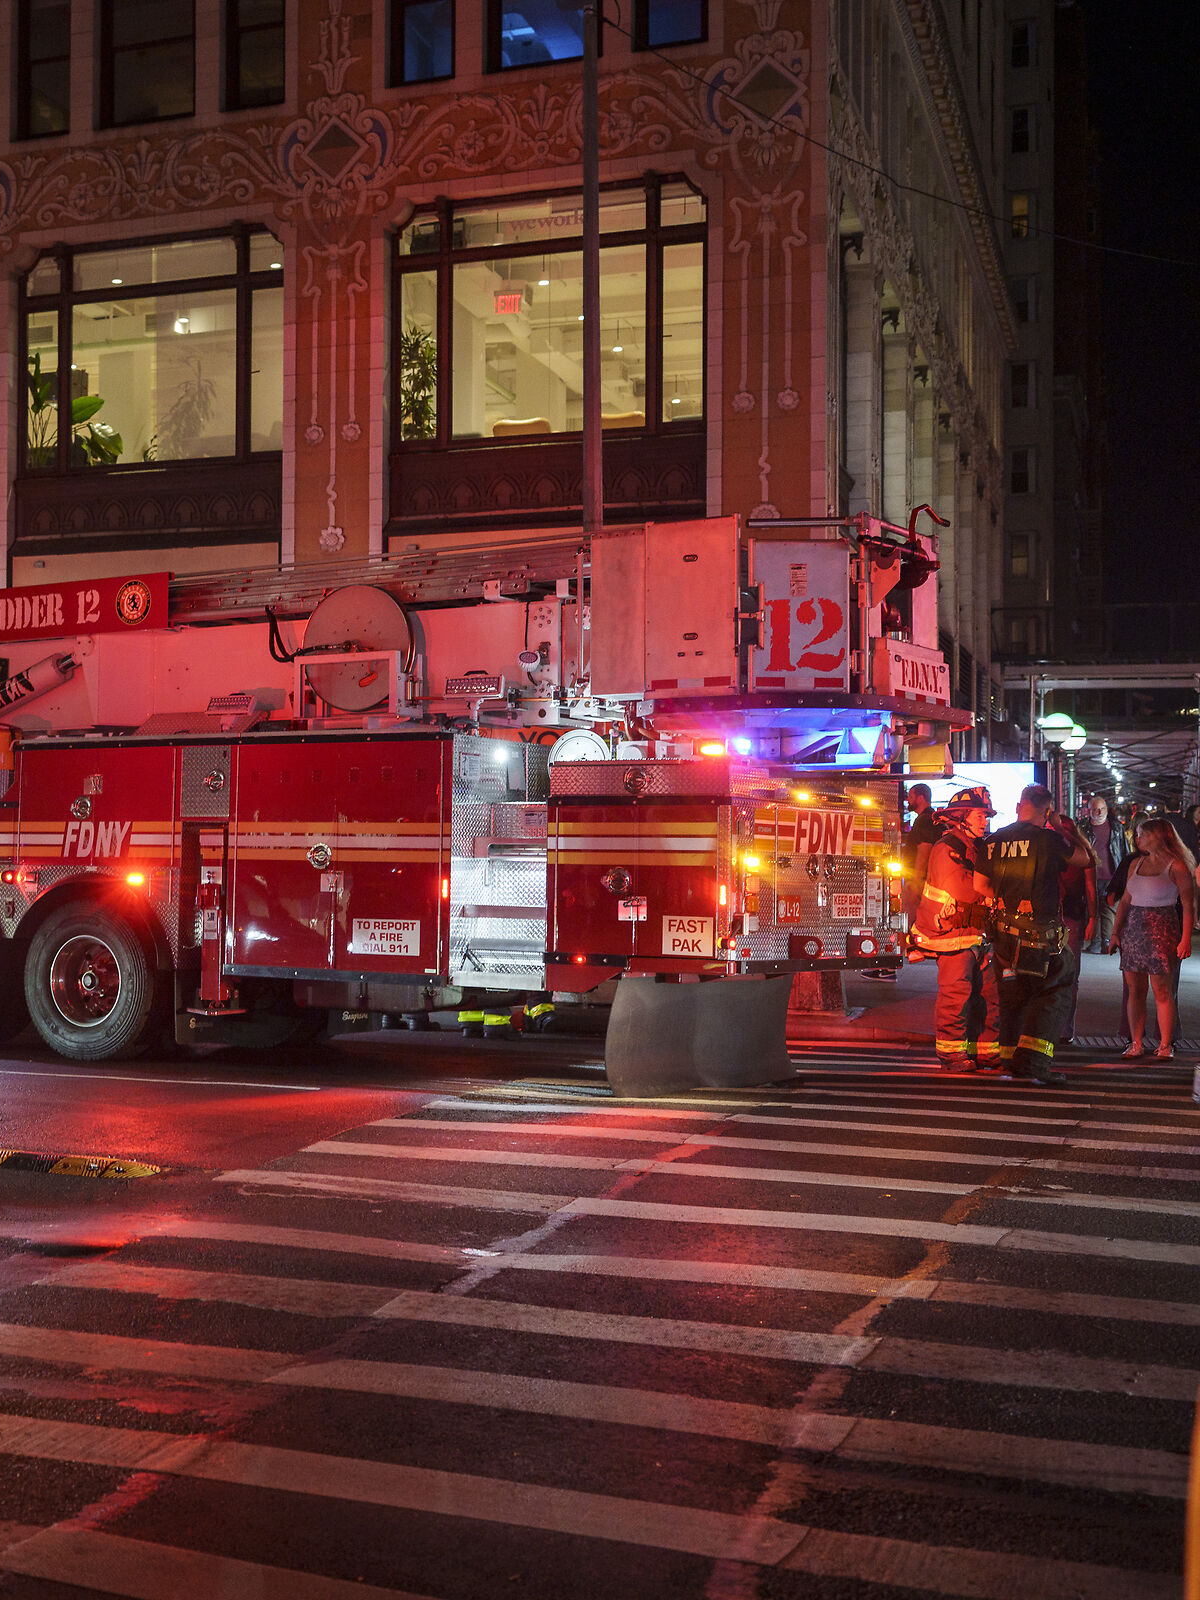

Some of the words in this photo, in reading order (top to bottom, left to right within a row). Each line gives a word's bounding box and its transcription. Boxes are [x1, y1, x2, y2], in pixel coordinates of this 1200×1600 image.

[499, 294, 521, 315] EXIT
[76, 589, 100, 625] 12
[764, 597, 845, 672] 12
[902, 658, 942, 694] F.D.N.Y.
[63, 821, 131, 858] FDNY
[795, 811, 854, 855] FDNY
[987, 840, 1030, 860] FDNY
[834, 895, 848, 905] KEEP
[849, 896, 864, 906] BACK
[786, 901, 800, 917] L-12
[837, 907, 848, 917] 200
[849, 907, 862, 917] FEET
[356, 921, 371, 930] TO
[373, 921, 416, 931] REPORT
[668, 919, 707, 933] FAST
[369, 932, 377, 941] A
[379, 933, 403, 942] FIRE
[672, 938, 702, 952] PAK
[362, 943, 386, 953] DIAL
[389, 944, 409, 953] 911
